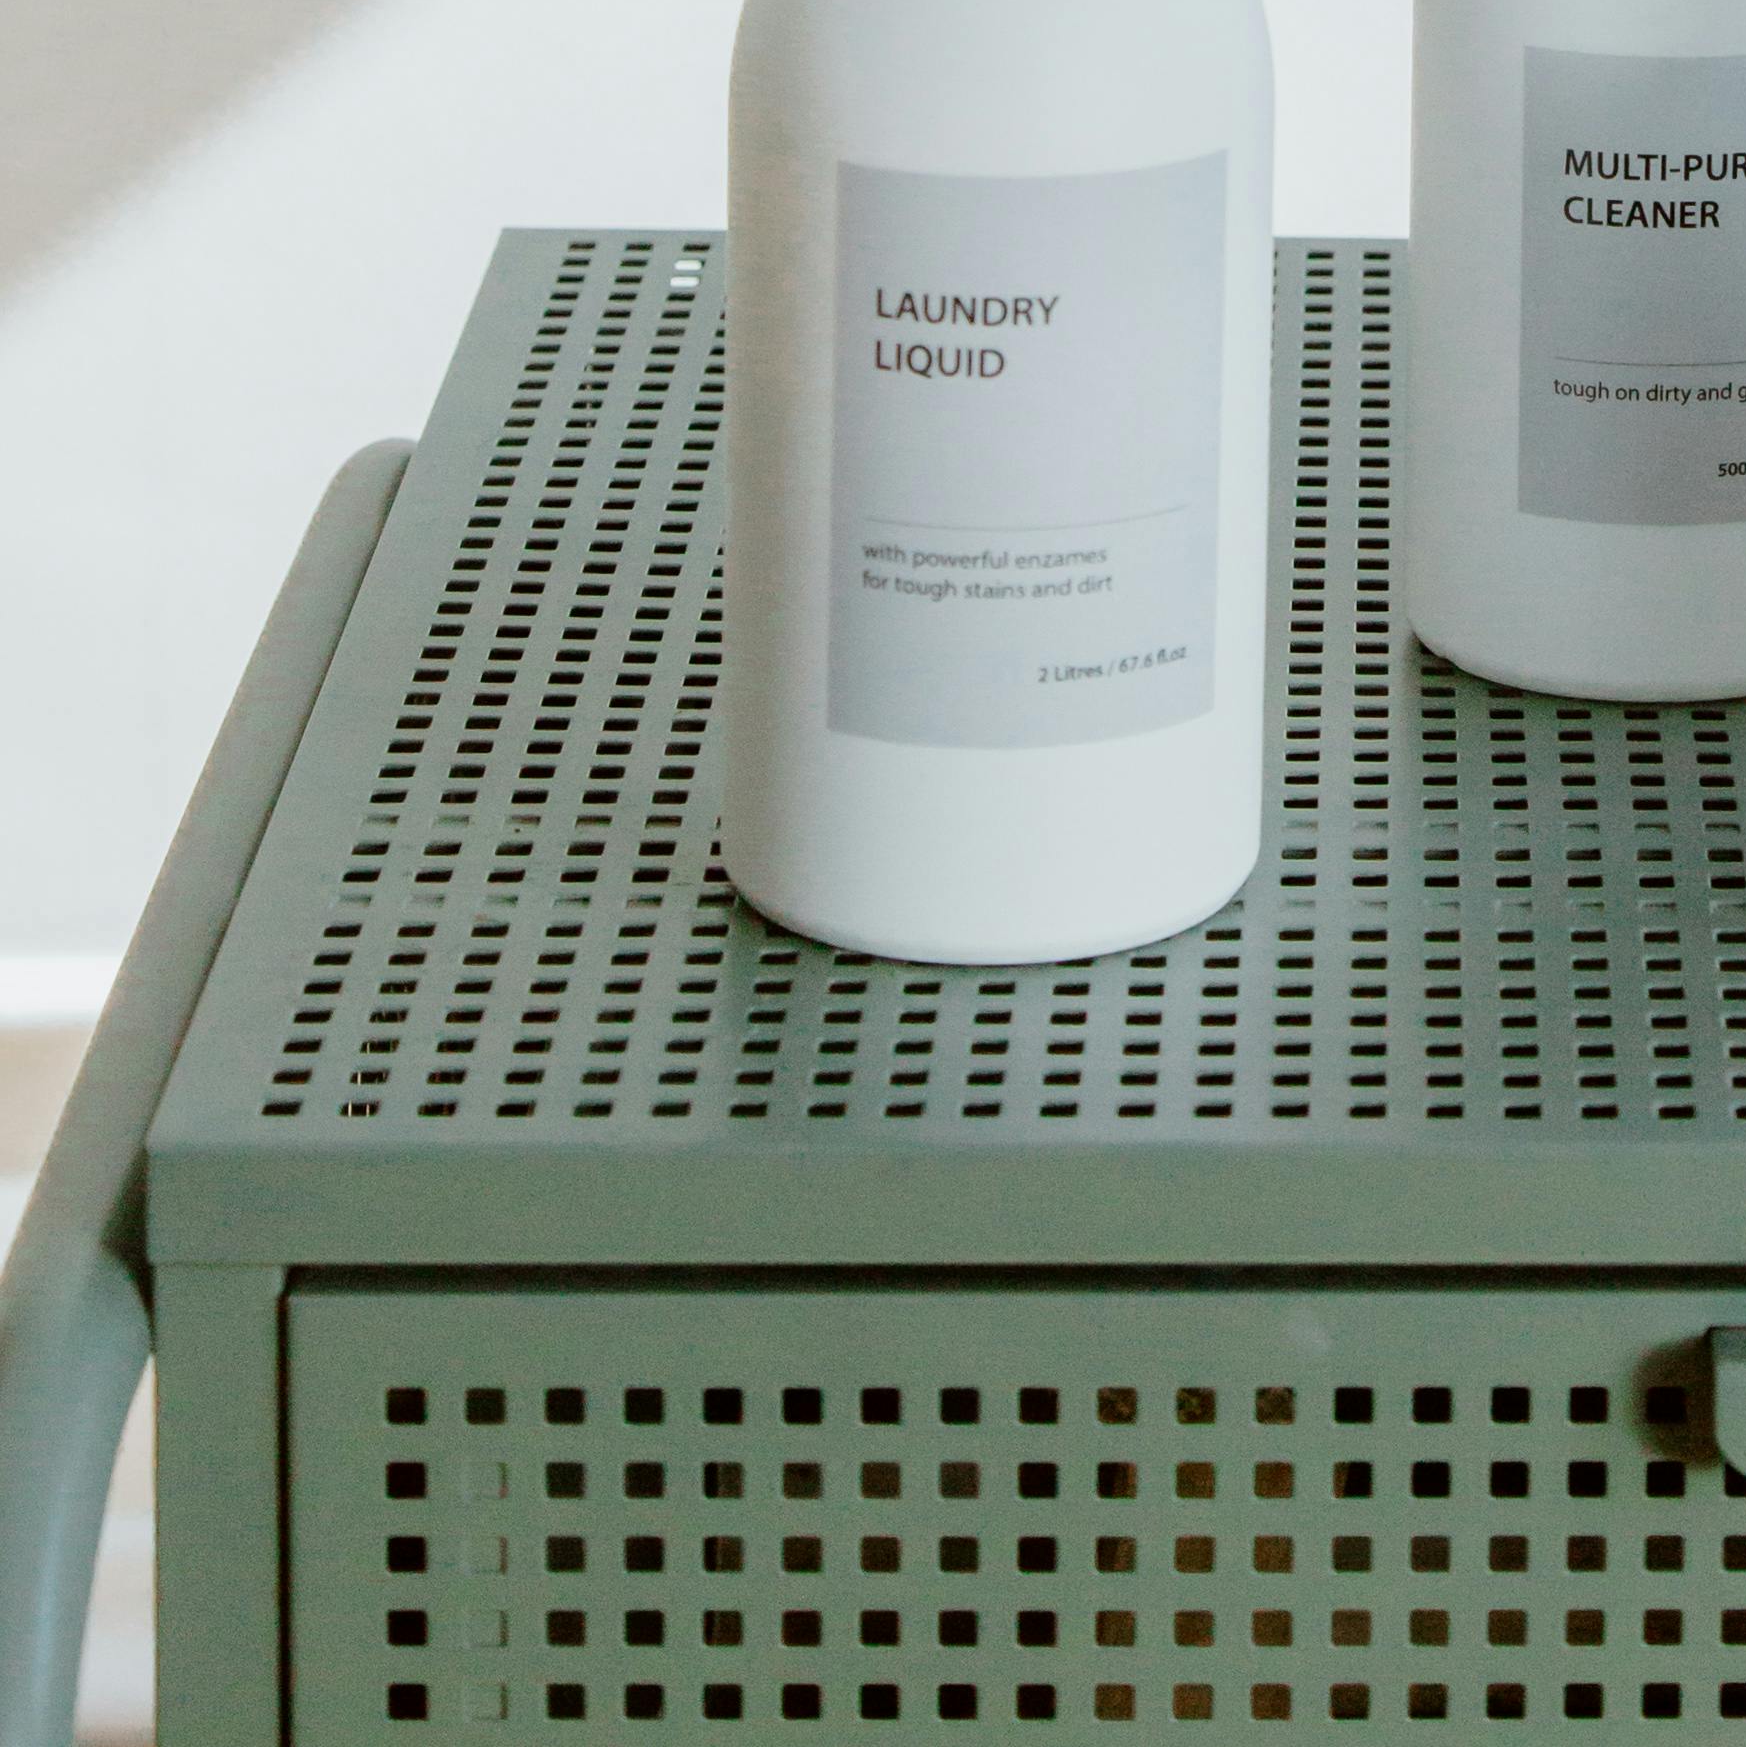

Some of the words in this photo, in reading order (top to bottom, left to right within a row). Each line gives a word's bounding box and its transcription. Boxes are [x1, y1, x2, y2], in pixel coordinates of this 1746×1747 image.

[1563, 196, 1720, 229] CLEANER
[876, 288, 1060, 326] LAUNDRY
[875, 340, 1006, 378] LIQUID
[1553, 379, 1609, 403] tough
[1615, 387, 1640, 401] on
[1646, 384, 1692, 405] dirty
[1696, 382, 1732, 400] and
[862, 544, 907, 563] with
[911, 550, 1009, 571] powerful
[862, 570, 888, 590] for
[894, 578, 957, 603] tough
[963, 581, 1025, 599] stains
[1031, 578, 1073, 599] and
[1077, 575, 1112, 596] dirt
[1038, 667, 1049, 683] 2
[1055, 665, 1103, 682] Litres
[1118, 652, 1153, 674] 67.6
